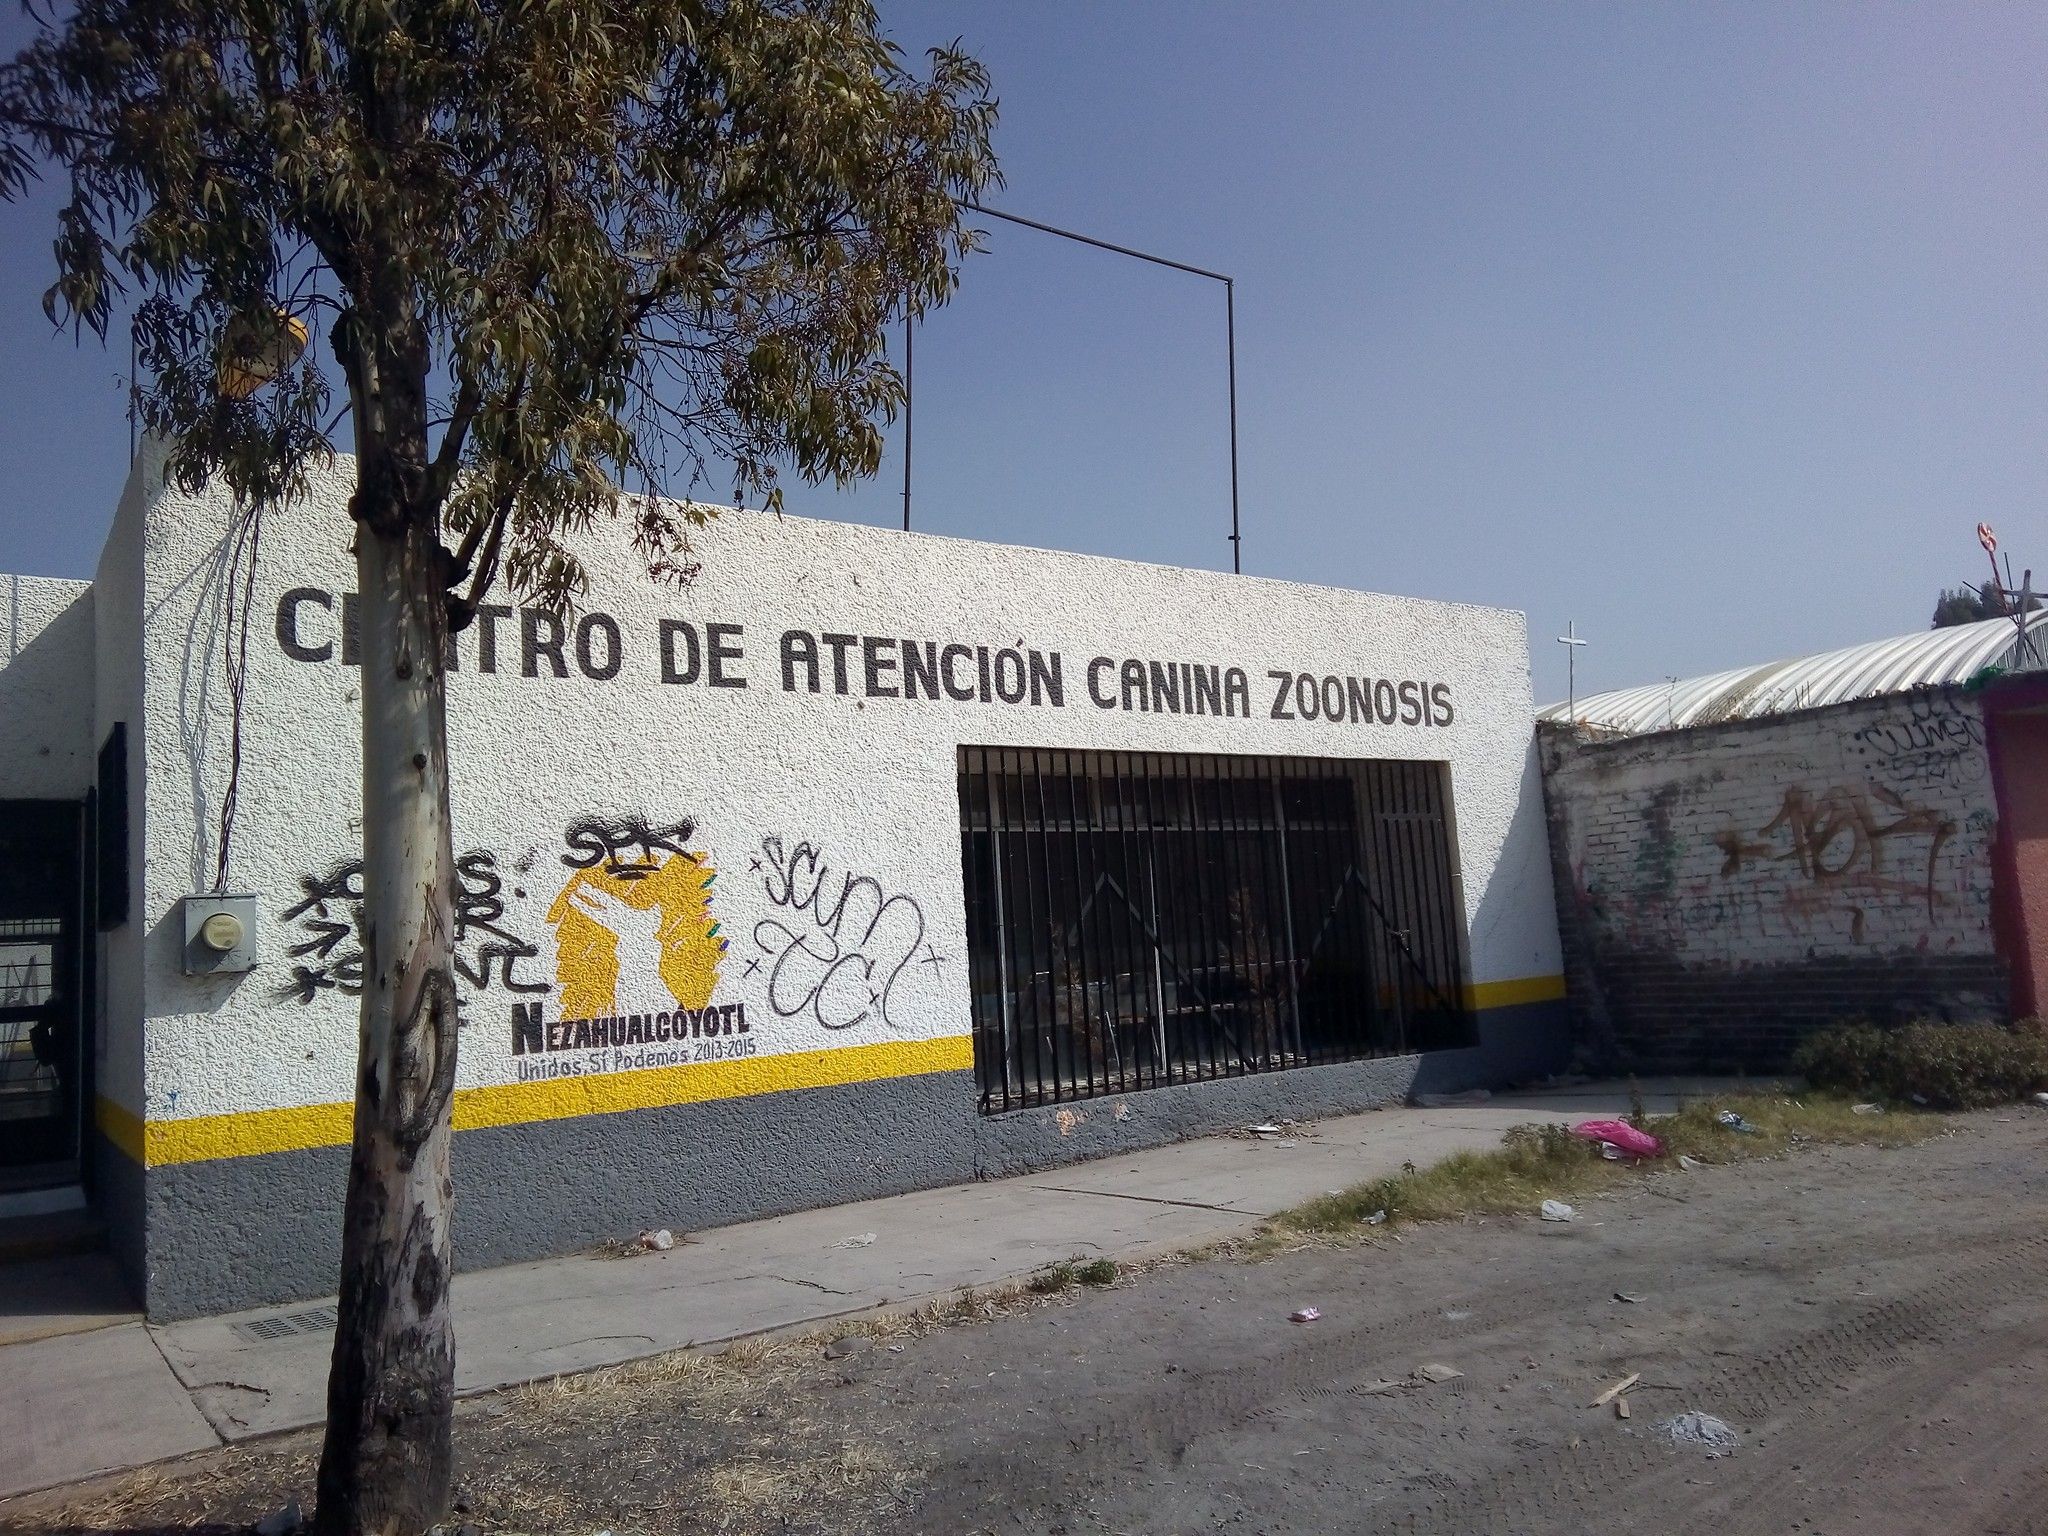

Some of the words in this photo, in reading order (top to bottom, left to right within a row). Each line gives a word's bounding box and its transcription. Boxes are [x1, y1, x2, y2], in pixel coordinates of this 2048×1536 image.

[275, 587, 622, 681] CTRO
[659, 618, 748, 688] DE
[779, 629, 1065, 708] ATENCIÓN
[1087, 655, 1251, 718] CANINA
[1267, 670, 1454, 727] ZOONOSIS
[613, 1046, 689, 1073] Podemos
